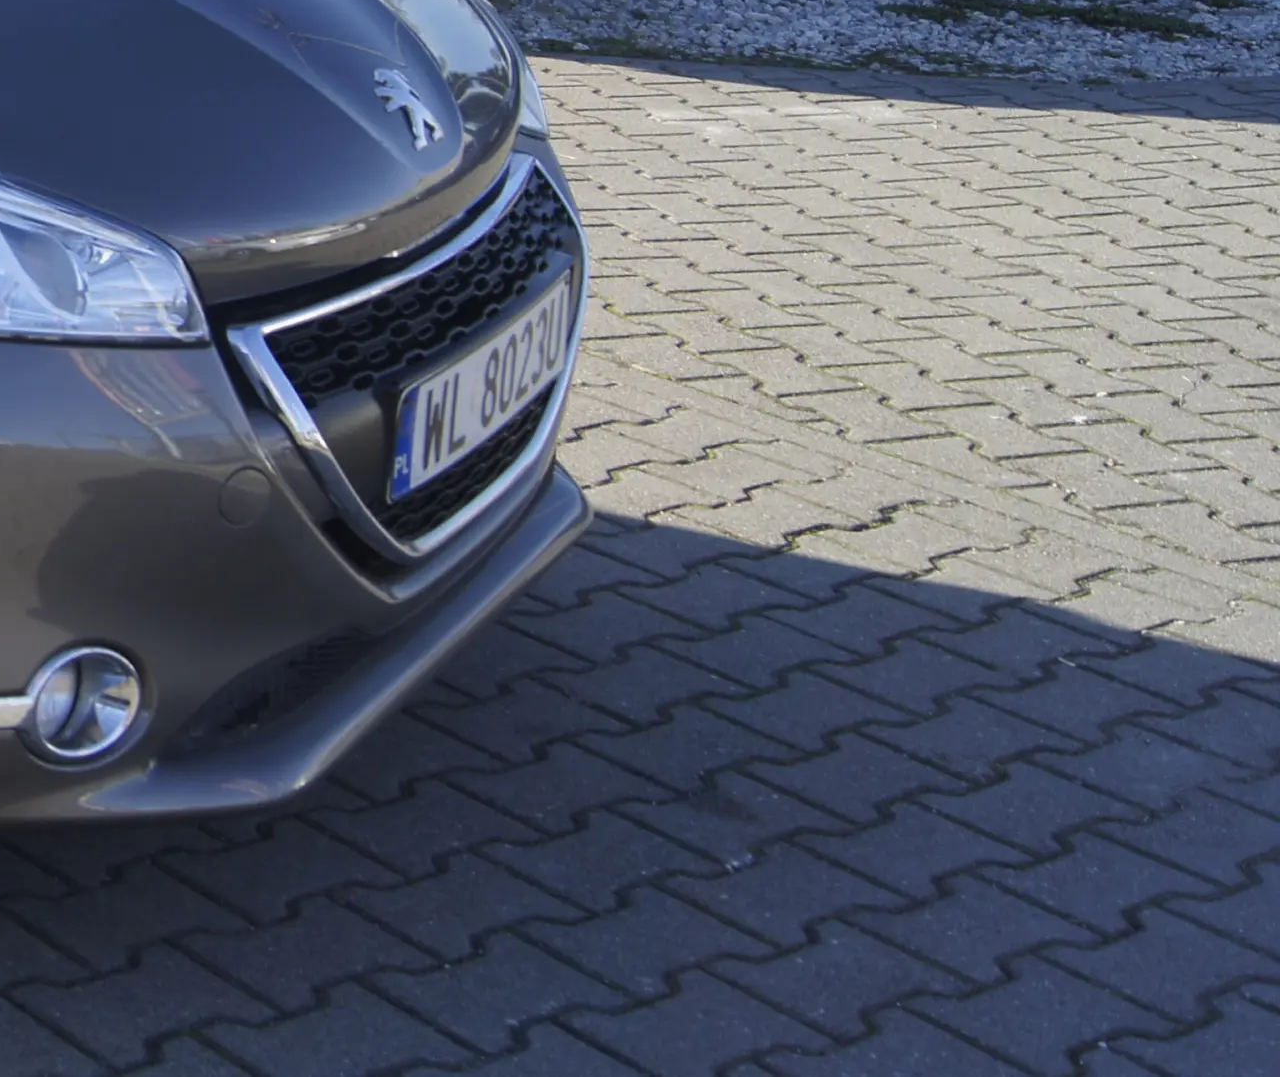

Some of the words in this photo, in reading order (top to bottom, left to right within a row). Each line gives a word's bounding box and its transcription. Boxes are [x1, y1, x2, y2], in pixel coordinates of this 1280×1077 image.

[422, 373, 466, 471] WL
[481, 289, 565, 428] 8023U
[394, 453, 410, 480] PL
